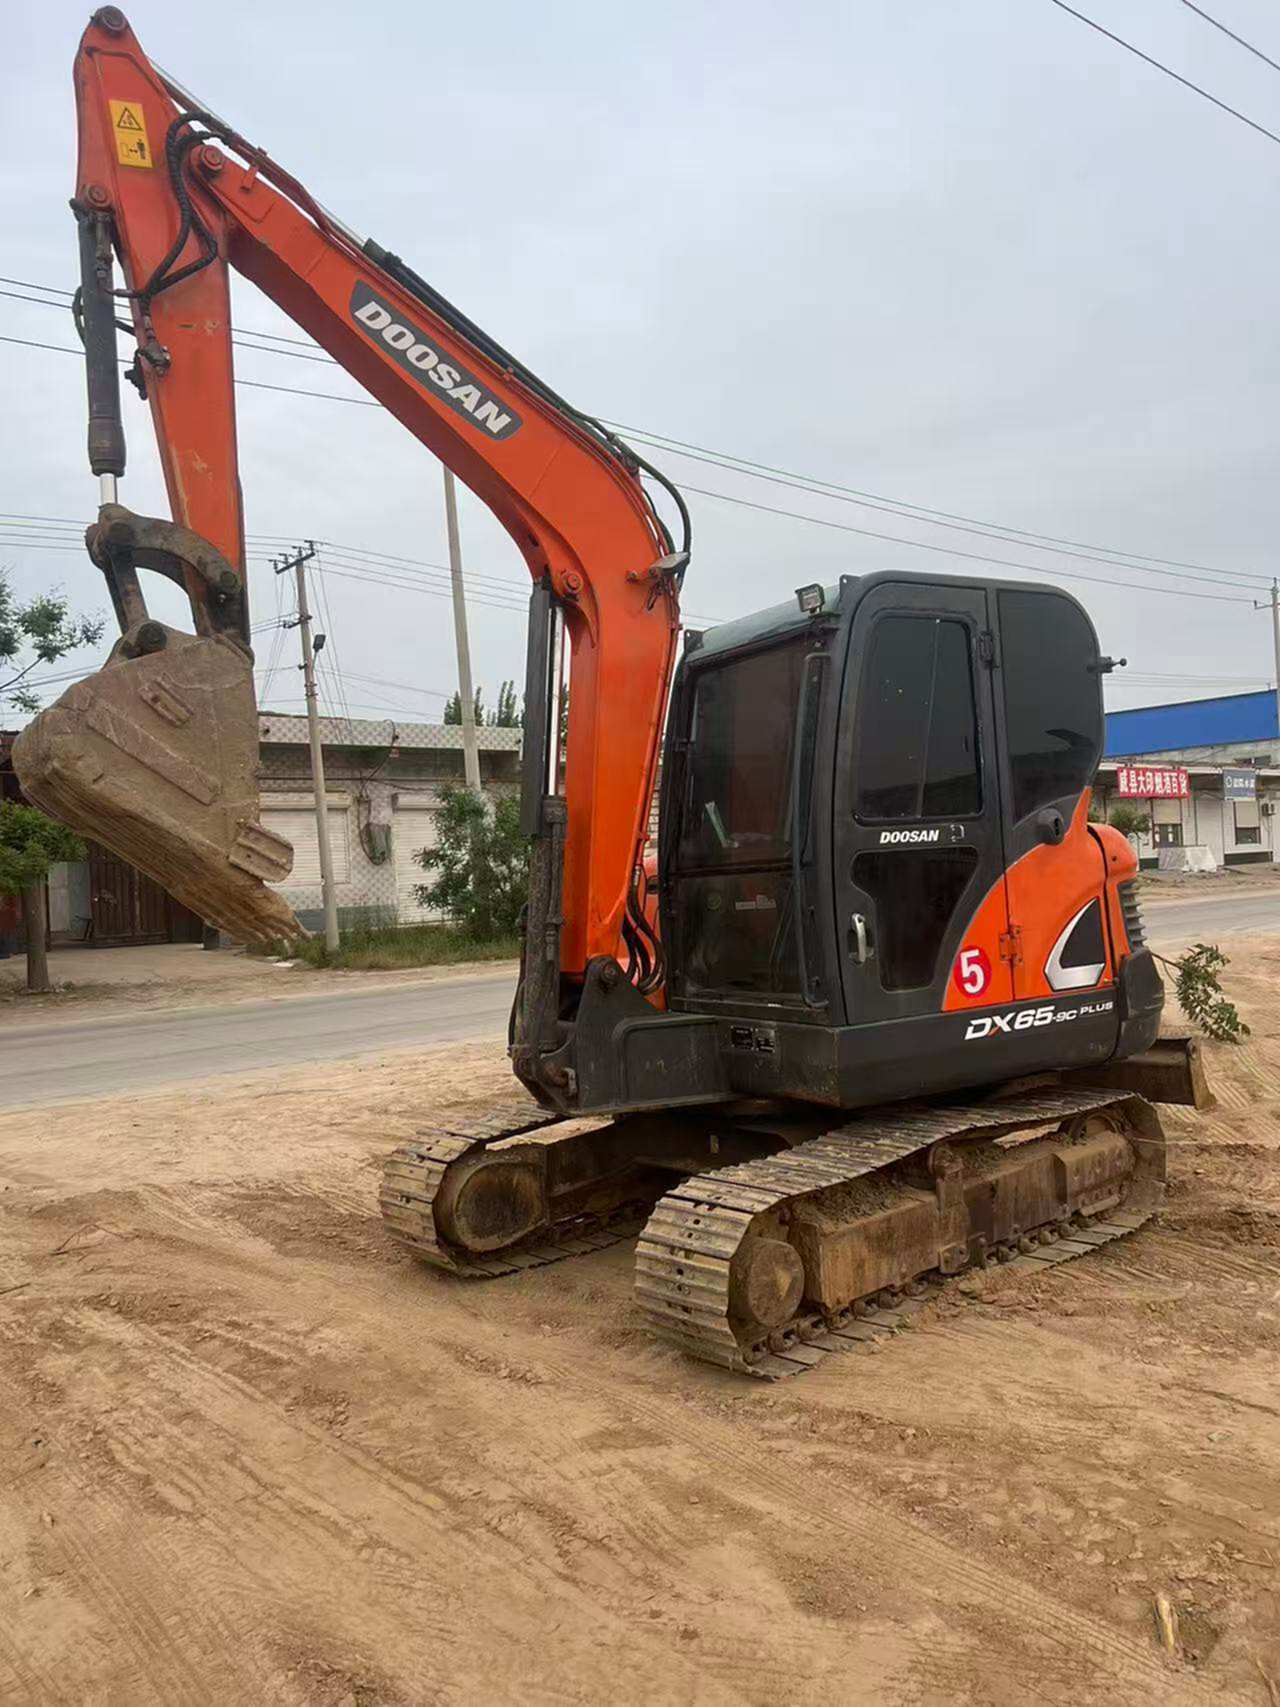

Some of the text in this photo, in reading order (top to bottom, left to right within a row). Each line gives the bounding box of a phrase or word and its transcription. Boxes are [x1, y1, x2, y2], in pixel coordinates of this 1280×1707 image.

[354, 301, 512, 434] DOOSAN
[880, 830, 939, 844] DOOSAN
[960, 949, 985, 994] 5
[1080, 1001, 1114, 1015] PLUS
